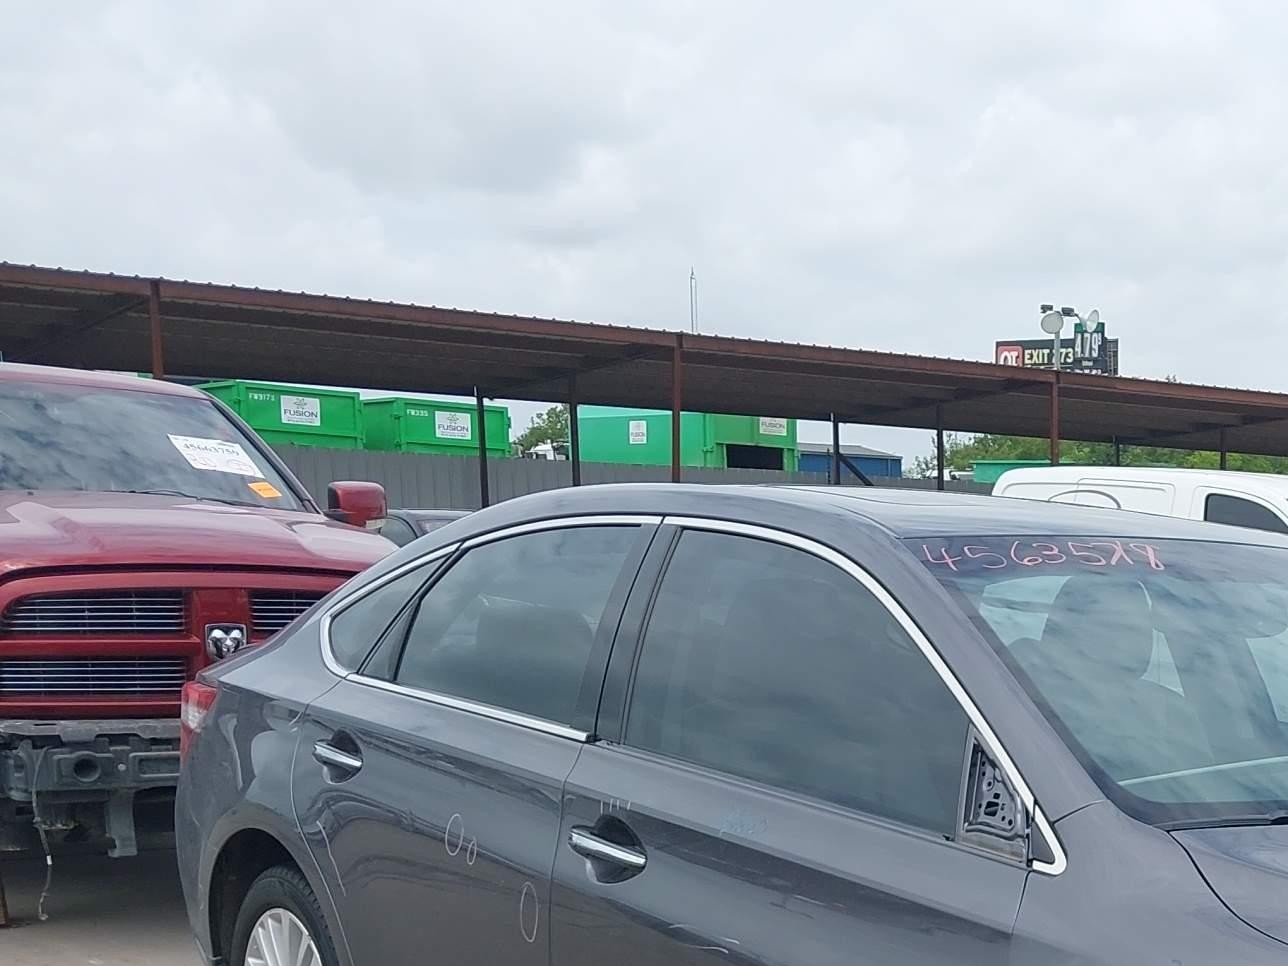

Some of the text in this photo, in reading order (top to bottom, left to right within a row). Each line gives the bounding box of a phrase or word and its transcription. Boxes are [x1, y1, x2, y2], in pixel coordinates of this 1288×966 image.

[1024, 348, 1050, 364] EXIT
[283, 408, 318, 418] FUSION
[438, 423, 469, 433] FUSION
[761, 420, 785, 429] FUSION
